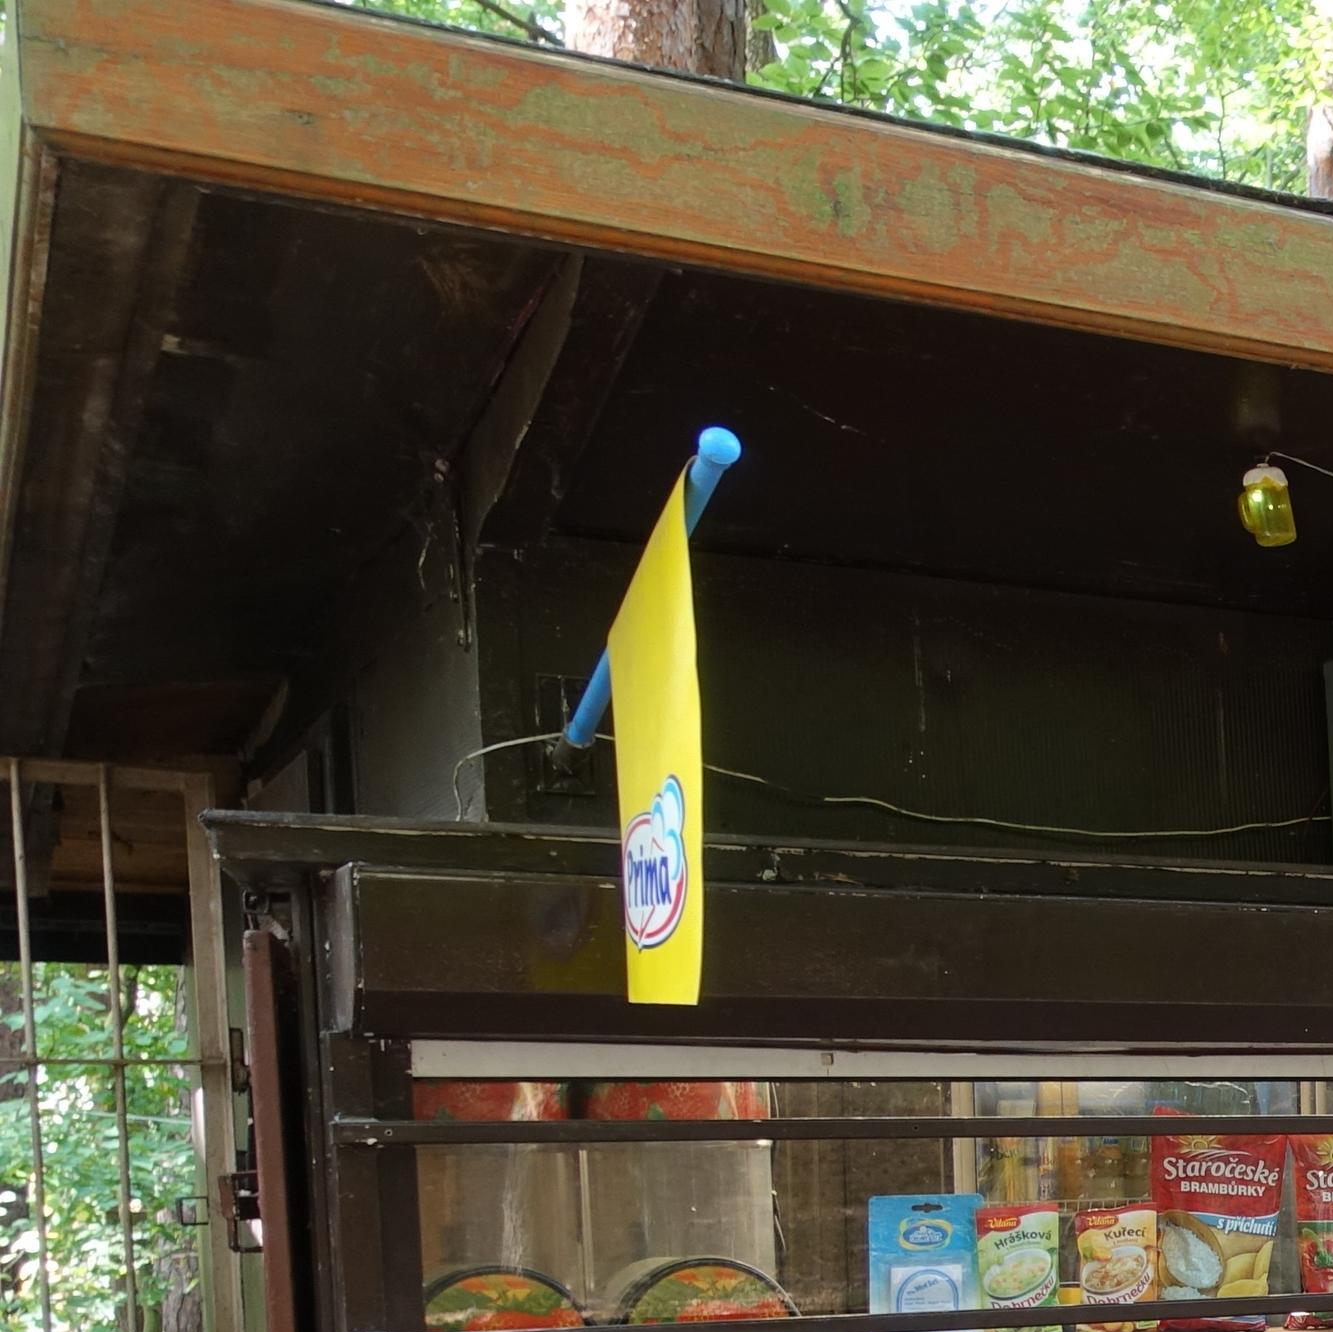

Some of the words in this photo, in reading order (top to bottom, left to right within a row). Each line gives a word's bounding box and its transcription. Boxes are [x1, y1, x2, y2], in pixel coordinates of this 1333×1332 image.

[627, 844, 672, 908] Prima
[1163, 1157, 1280, 1188] Staročeské
[1180, 1180, 1266, 1197] BRAMBŮRKY
[993, 1229, 1053, 1251] Hrášková
[1104, 1226, 1147, 1242] Kuřecí
